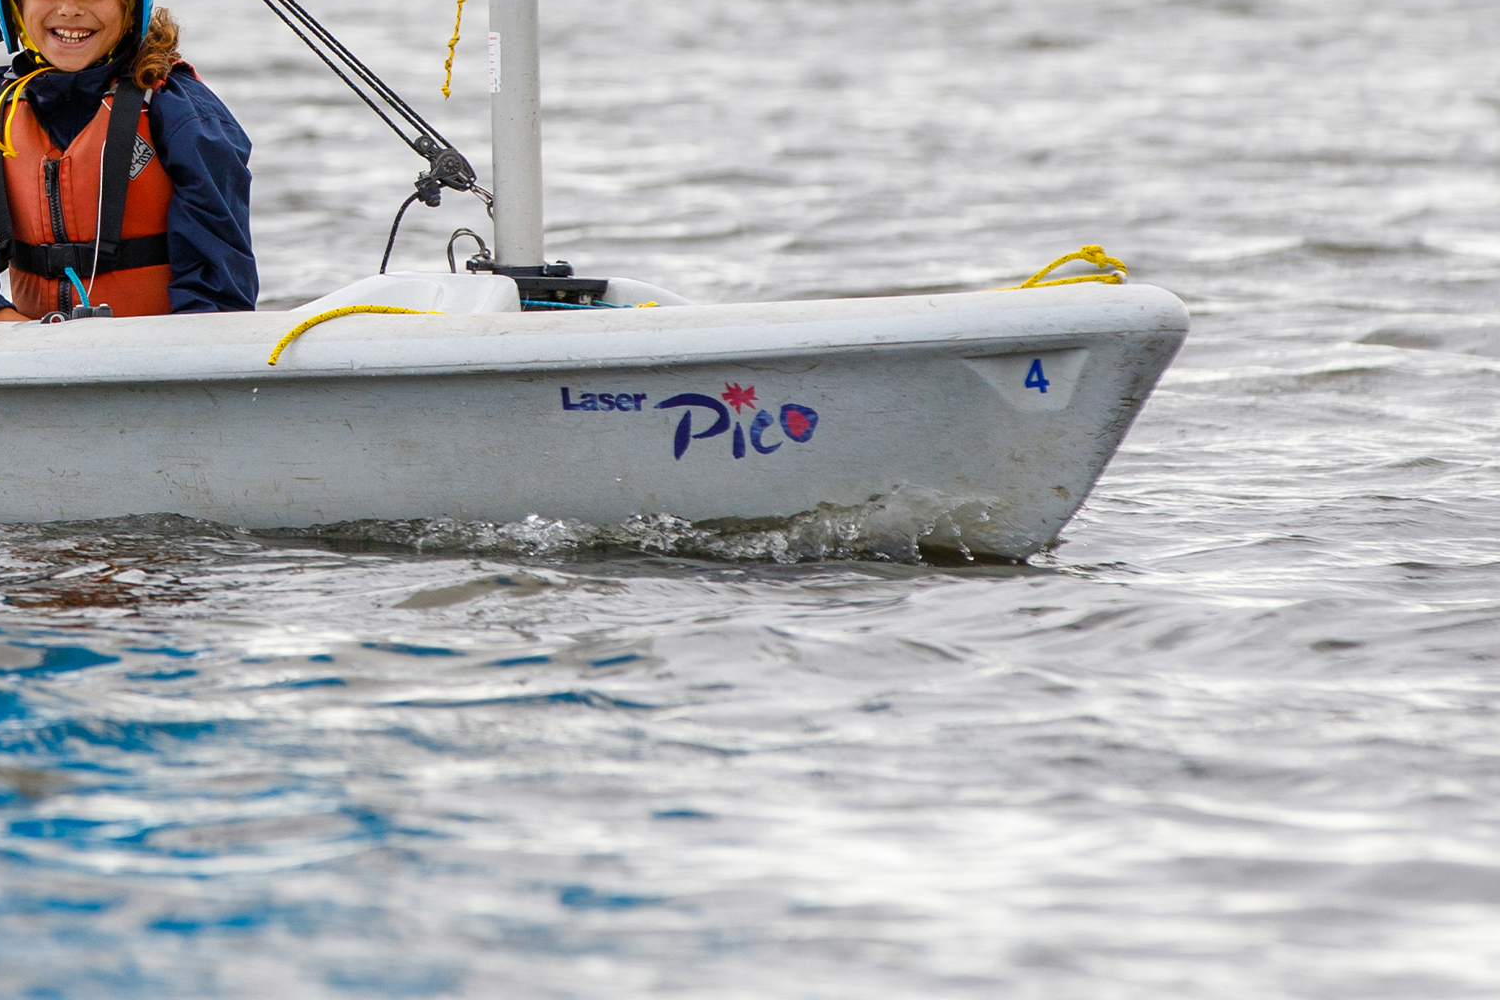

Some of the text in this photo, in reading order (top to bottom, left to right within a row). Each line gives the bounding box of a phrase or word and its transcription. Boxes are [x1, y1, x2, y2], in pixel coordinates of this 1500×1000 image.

[1025, 358, 1050, 394] 4
[561, 382, 820, 461] Laser Pico
